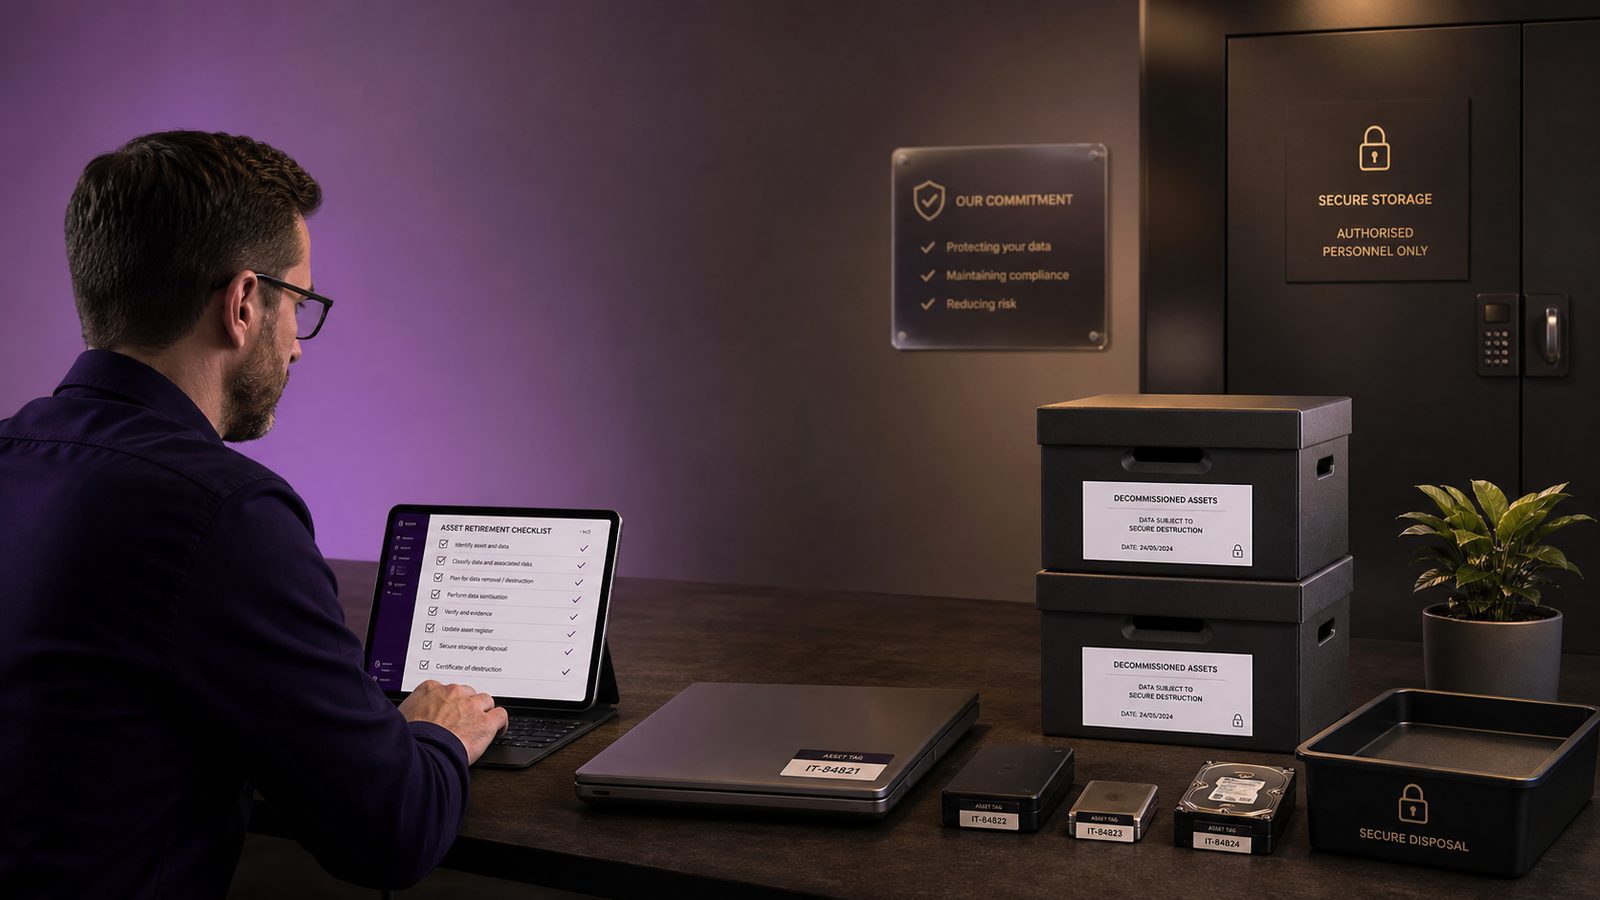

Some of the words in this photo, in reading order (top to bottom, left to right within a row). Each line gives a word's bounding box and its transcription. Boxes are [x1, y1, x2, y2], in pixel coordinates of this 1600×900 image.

[956, 195, 983, 207] OUR
[986, 194, 1074, 206] COMMITMENT
[1319, 194, 1368, 206] SECURE
[1372, 193, 1432, 205] STORAGE
[1337, 227, 1414, 239] AUTHORISED
[946, 241, 1000, 254] Protecting
[1002, 243, 1026, 254] your
[1028, 241, 1051, 252] data
[1323, 246, 1393, 257] PERSONNEL
[1397, 245, 1428, 256] ONLY
[946, 269, 1007, 283] Maintaining
[1009, 269, 1070, 282] compliance
[946, 298, 995, 312] Reducing
[998, 298, 1017, 309] risk
[1114, 494, 1186, 503] DECOMMISSIONED
[1187, 496, 1218, 504] ASSETS
[440, 524, 463, 532] ASSET
[464, 525, 510, 533] RETIREMENT
[511, 526, 552, 535] CHECKLIST
[1129, 525, 1155, 533] SECURE
[1156, 526, 1203, 534] DESTRUCTION
[1139, 544, 1174, 552] 24/05/2024
[452, 558, 471, 566] Classify
[447, 591, 467, 599] Perform
[475, 627, 494, 635] register
[439, 642, 457, 650] Secure
[457, 643, 478, 651] storage
[485, 645, 508, 653] disposal
[436, 663, 464, 671] Certificate
[471, 665, 502, 673] destruction
[1114, 661, 1186, 671] DECOMMISSIONED
[1187, 664, 1218, 673] ASSETS
[1129, 692, 1155, 700] SECURE
[1155, 693, 1203, 702] DESTRUCTION
[1139, 712, 1174, 720] 24/05/2024
[805, 764, 861, 775] IT-84821
[971, 815, 1007, 825] IT-84822
[1087, 827, 1123, 837] IT-84823
[1204, 837, 1240, 848] IT-84824
[1359, 828, 1406, 843] SECURE
[1409, 834, 1470, 852] DISPOSAL
